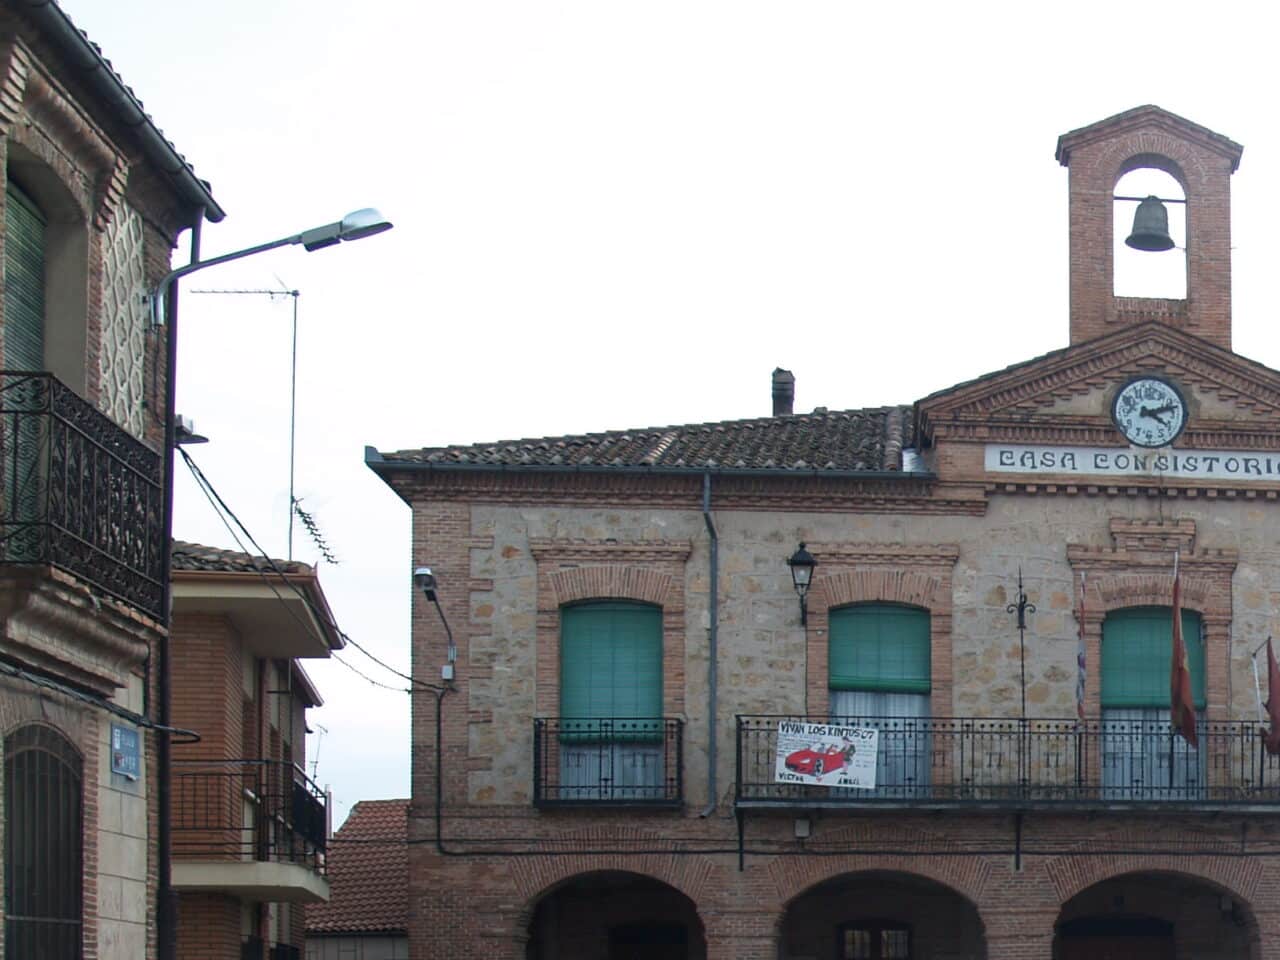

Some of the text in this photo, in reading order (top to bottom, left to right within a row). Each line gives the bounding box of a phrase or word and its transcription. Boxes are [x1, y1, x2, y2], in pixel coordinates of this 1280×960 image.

[999, 449, 1078, 469] CASA
[807, 725, 826, 736] LOS
[827, 726, 860, 738] KINTOS
